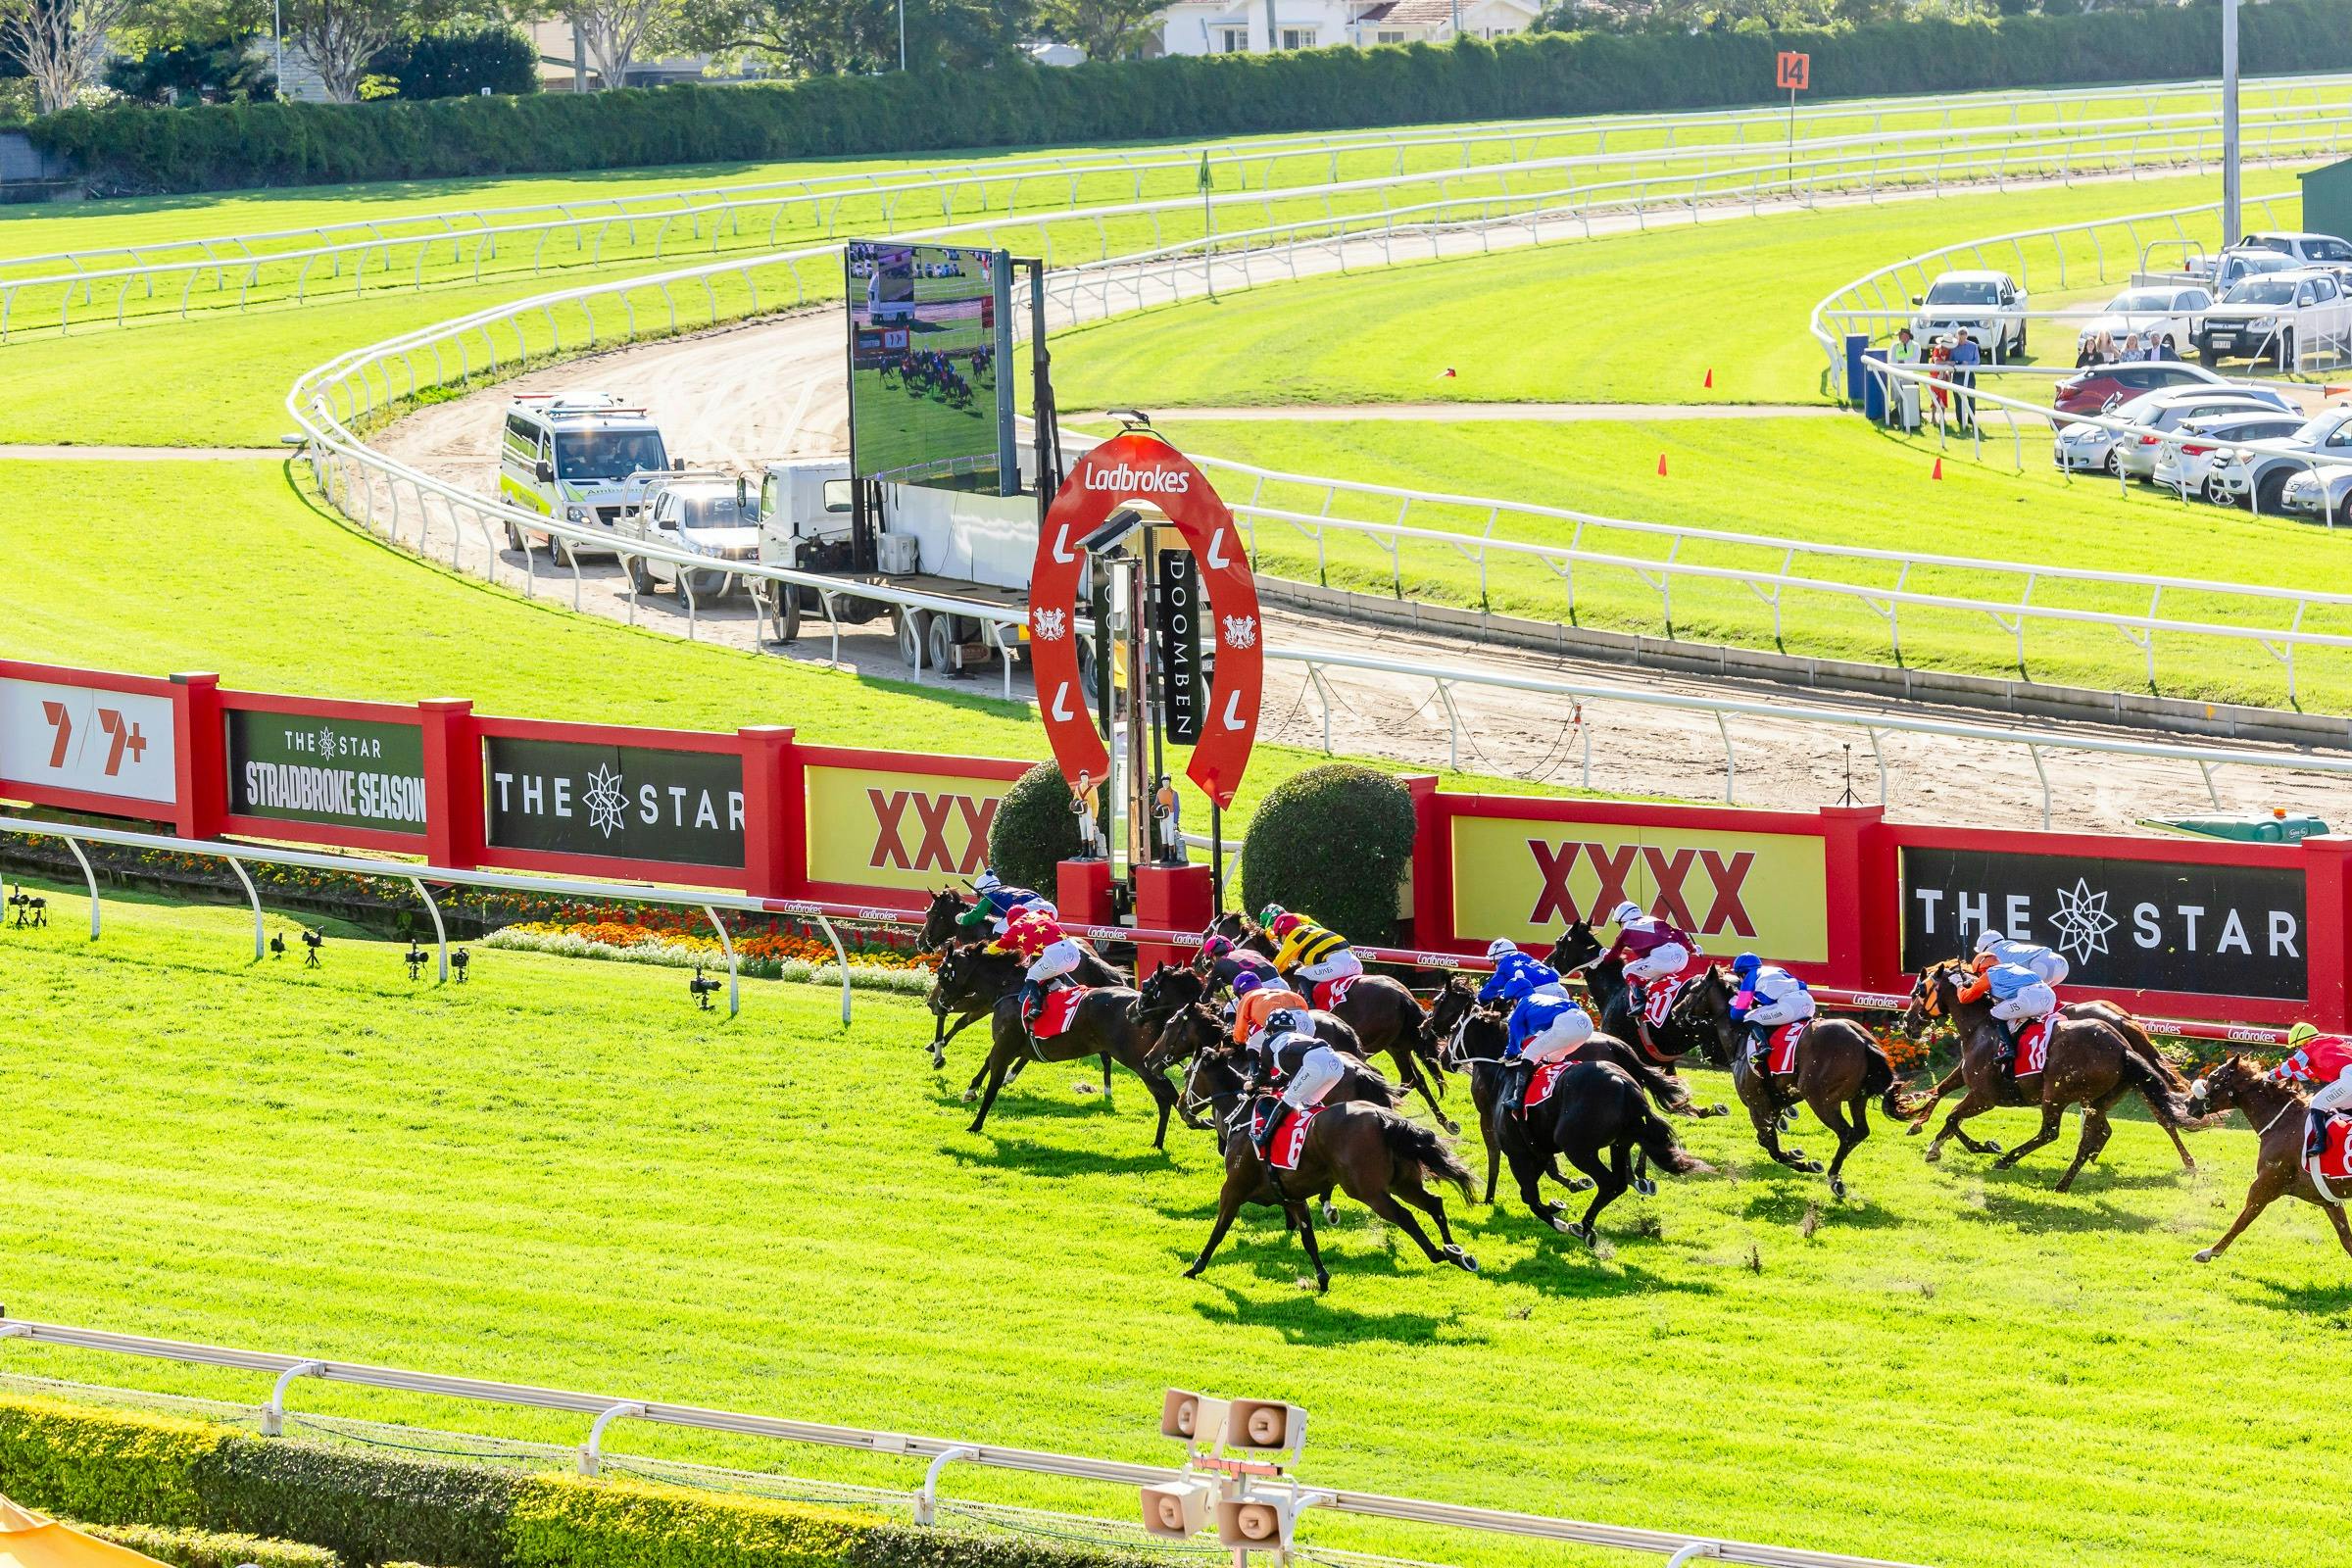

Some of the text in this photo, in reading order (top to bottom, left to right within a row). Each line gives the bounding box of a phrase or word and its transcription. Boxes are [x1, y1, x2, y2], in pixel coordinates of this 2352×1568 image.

[1783, 57, 1804, 84] 14
[1085, 463, 1189, 493] Ladbrokes
[1170, 560, 1193, 734] DOOMBEN
[285, 730, 381, 759] THE STAR
[246, 760, 427, 823] STRADBROKE SEASON
[495, 772, 745, 830] THE STAR
[1526, 839, 1758, 938] XXXX
[784, 901, 822, 915] Ladbrokes
[858, 907, 898, 922] Ladbrokes
[1087, 926, 1127, 940] Ladbrokes
[1916, 889, 2299, 958] THE STAR
[1417, 954, 1459, 968] Ladbrokes
[1852, 994, 1899, 1008] Ladbrokes
[2228, 1028, 2277, 1043] Ladbrokes
[1782, 1035, 1797, 1071] 7
[1288, 1128, 1304, 1169] 6
